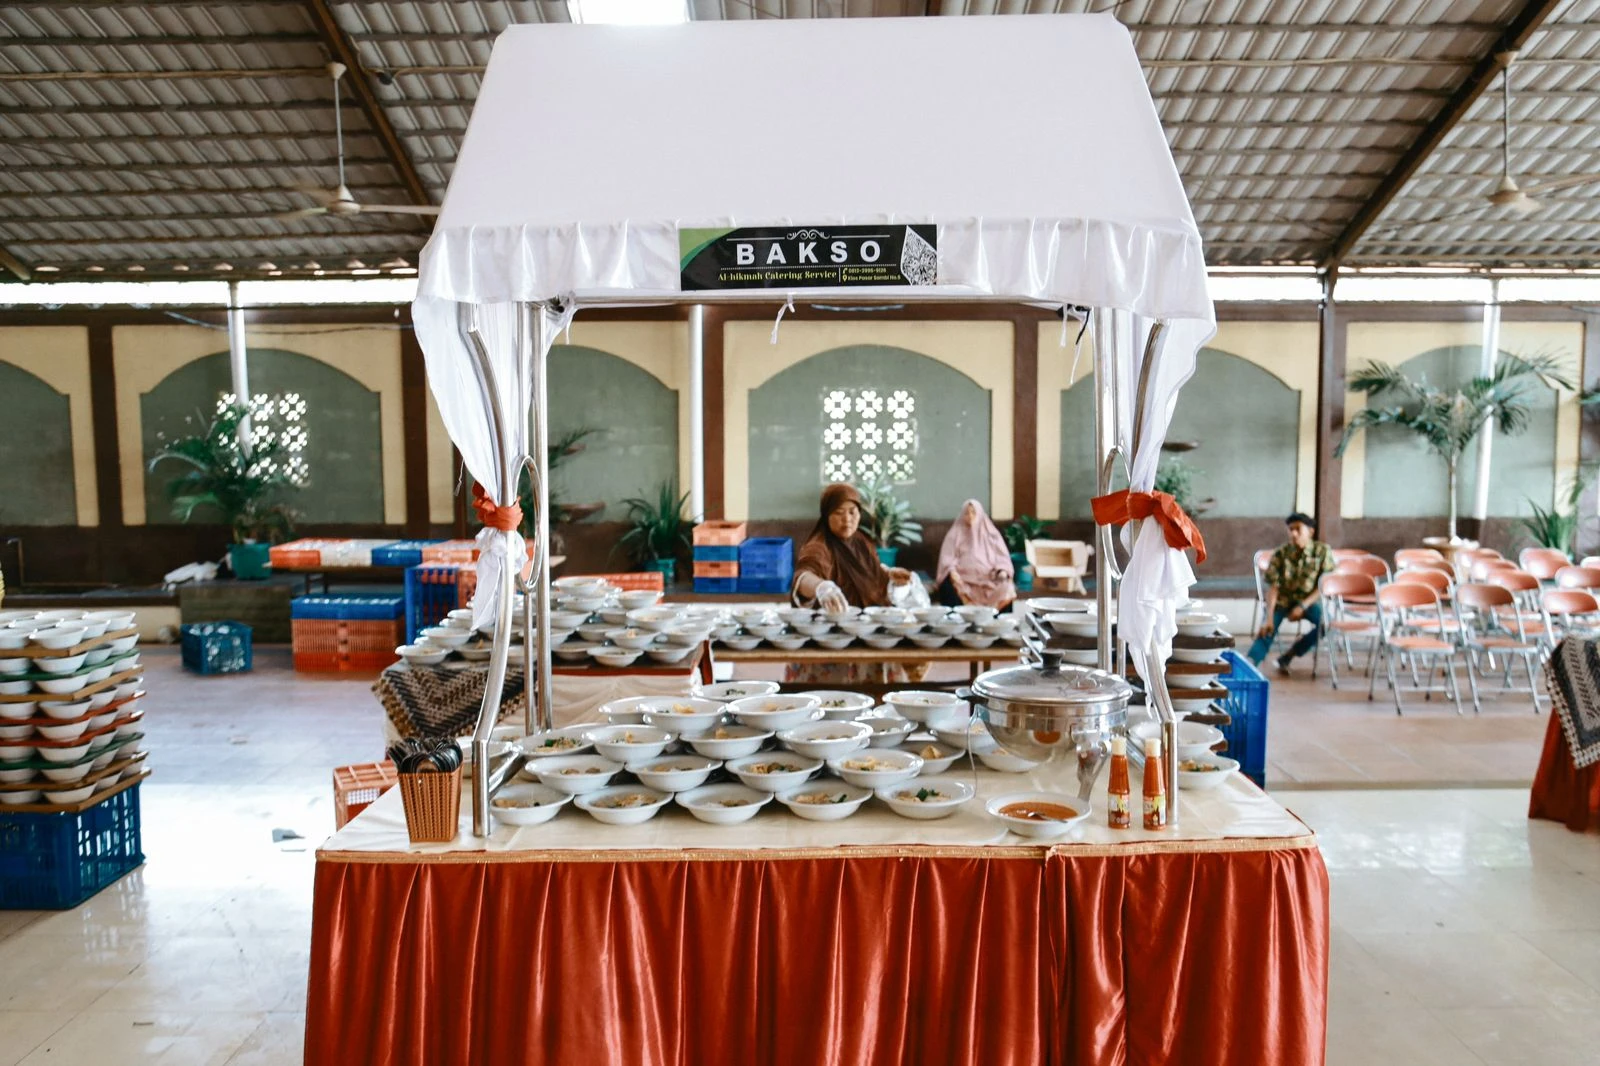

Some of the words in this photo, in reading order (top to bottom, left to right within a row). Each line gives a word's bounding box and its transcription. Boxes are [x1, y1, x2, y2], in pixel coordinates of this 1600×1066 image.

[736, 240, 881, 265] BAKSO
[765, 270, 802, 280] Catering
[804, 269, 837, 279] Service
